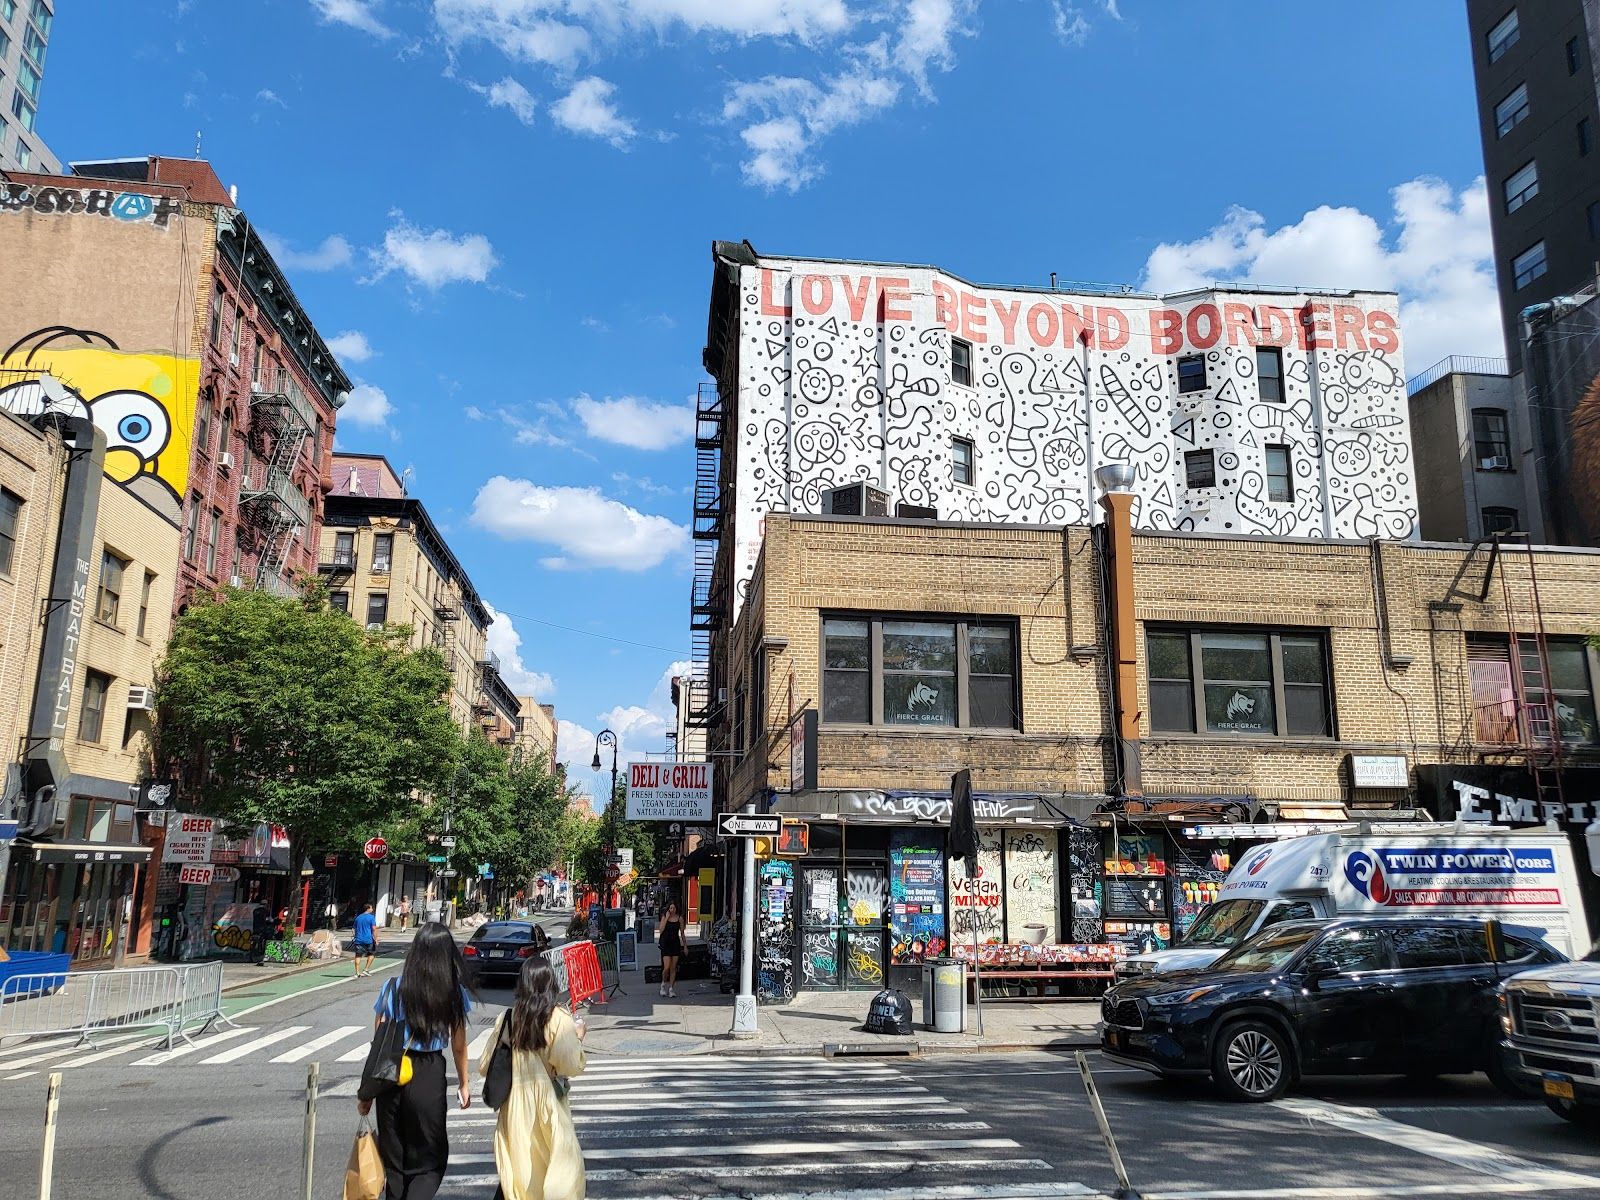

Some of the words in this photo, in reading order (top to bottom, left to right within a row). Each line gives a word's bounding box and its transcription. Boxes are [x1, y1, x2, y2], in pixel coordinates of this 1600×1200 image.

[761, 268, 913, 323] LOVE
[931, 279, 1130, 351] BEYOND
[1149, 302, 1400, 356] BORDERS
[76, 558, 90, 575] THE
[631, 764, 660, 788] DELI
[663, 768, 670, 785] &
[672, 765, 709, 789] GRILL
[631, 790, 653, 799] FRESH
[656, 791, 681, 799] TOSSED
[682, 791, 708, 799] SALADS
[641, 800, 664, 808] VEGAN
[666, 800, 698, 808] DELIGHTS
[1452, 779, 1600, 824] EMPI
[635, 808, 666, 816] NATURAL
[668, 808, 687, 816] JUICE
[689, 808, 703, 816] BAR
[182, 818, 212, 833] BEER
[728, 820, 747, 830] ONE
[754, 821, 774, 830] WAY
[366, 844, 387, 854] STOP
[1385, 854, 1437, 869] TWIN
[1441, 854, 1513, 869] POWER
[1515, 858, 1553, 869] CORP.
[181, 867, 211, 884] BEER
[1013, 872, 1054, 890] Coee
[1408, 877, 1436, 886] HEATING,
[1436, 877, 1464, 885] COOLING
[952, 877, 998, 897] Vegan
[1239, 880, 1268, 889] POWER
[954, 895, 1000, 907] MENU
[1394, 891, 1415, 905] SALES,
[1414, 891, 1456, 904] INSTALLATION,
[1456, 891, 1467, 903] AIR
[870, 1004, 895, 1017] LOWER
[868, 1014, 886, 1026] EAST
